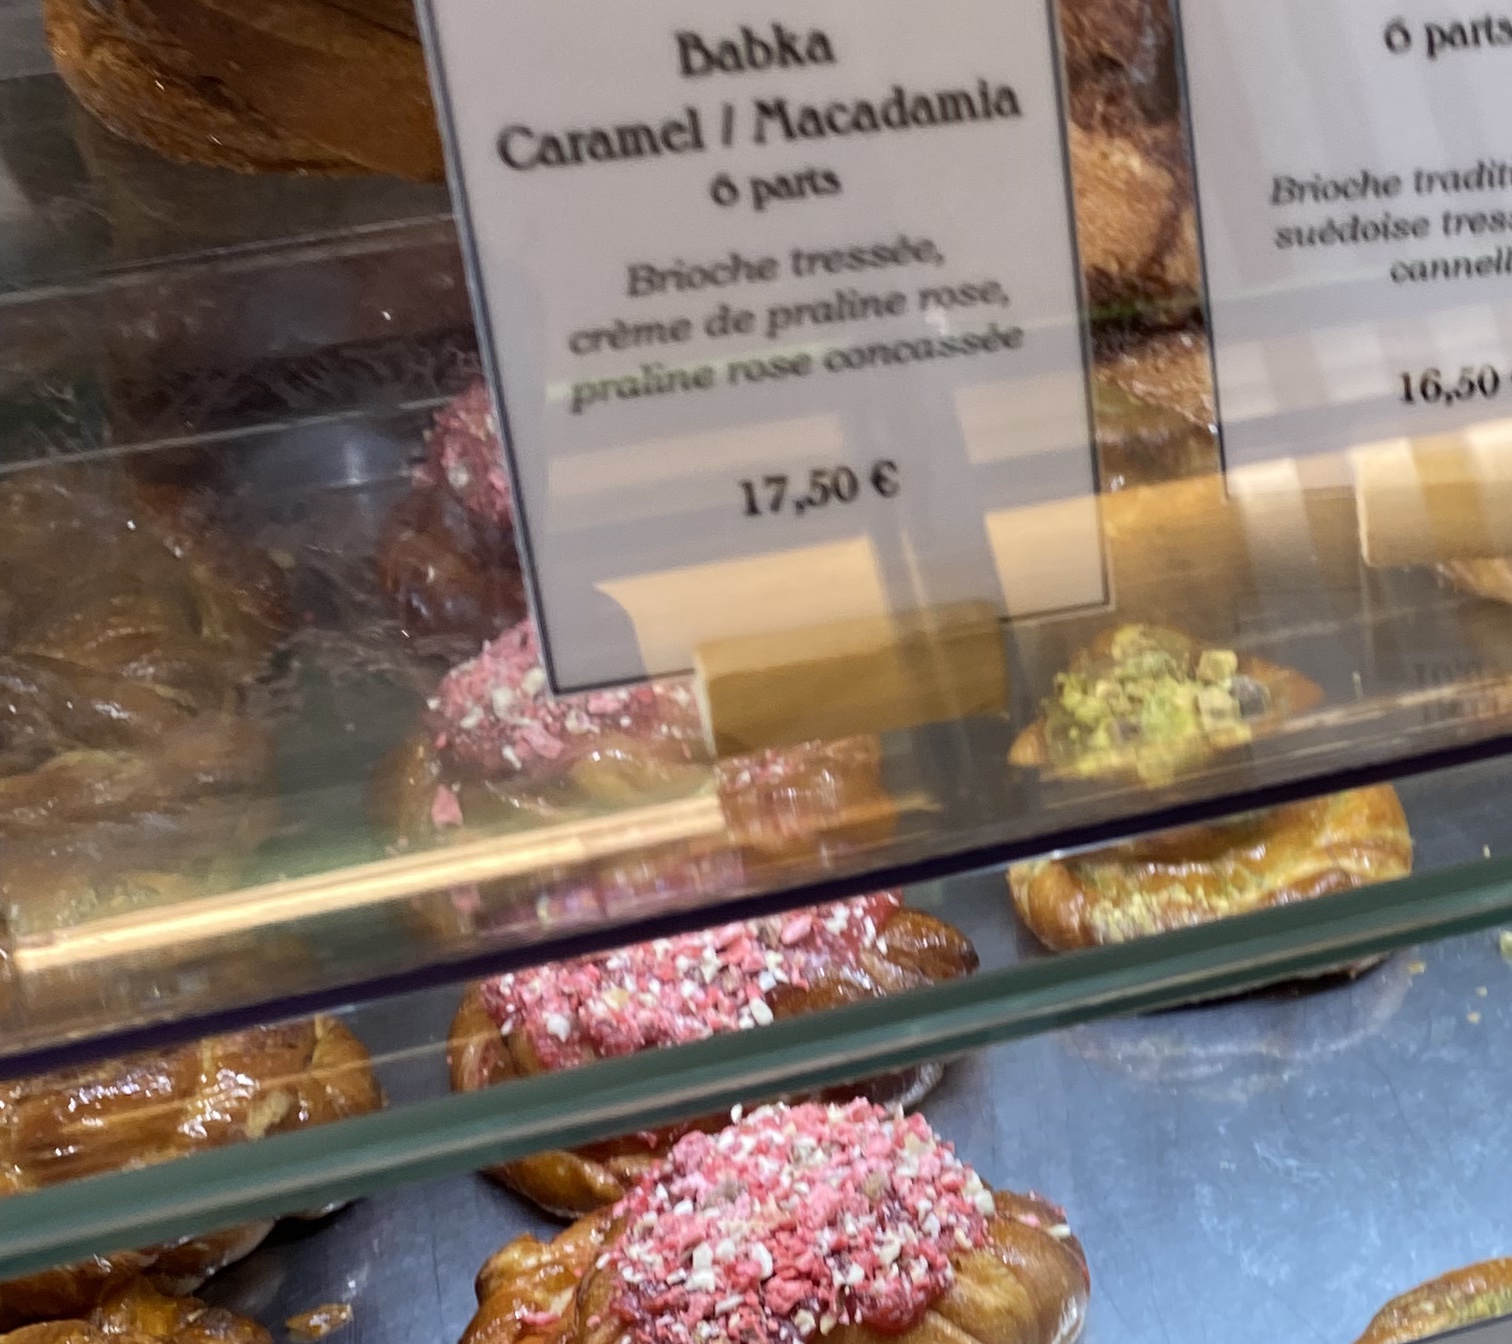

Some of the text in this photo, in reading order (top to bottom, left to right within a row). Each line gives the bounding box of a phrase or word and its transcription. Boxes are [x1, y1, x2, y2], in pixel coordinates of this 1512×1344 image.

[675, 22, 836, 77] Babka
[1383, 19, 1411, 52] 6
[495, 79, 1021, 171] Caramel / Macadamia
[709, 168, 841, 211] 6 parts
[1270, 169, 1401, 205] Brioche
[1274, 211, 1430, 249] suédoise
[626, 236, 944, 297] Brioche tressée,
[568, 280, 1009, 355] crème de praline rose,
[569, 323, 1023, 415] praline rose concassée
[1401, 368, 1500, 405] 16,50
[740, 460, 896, 517] 17,50 €
